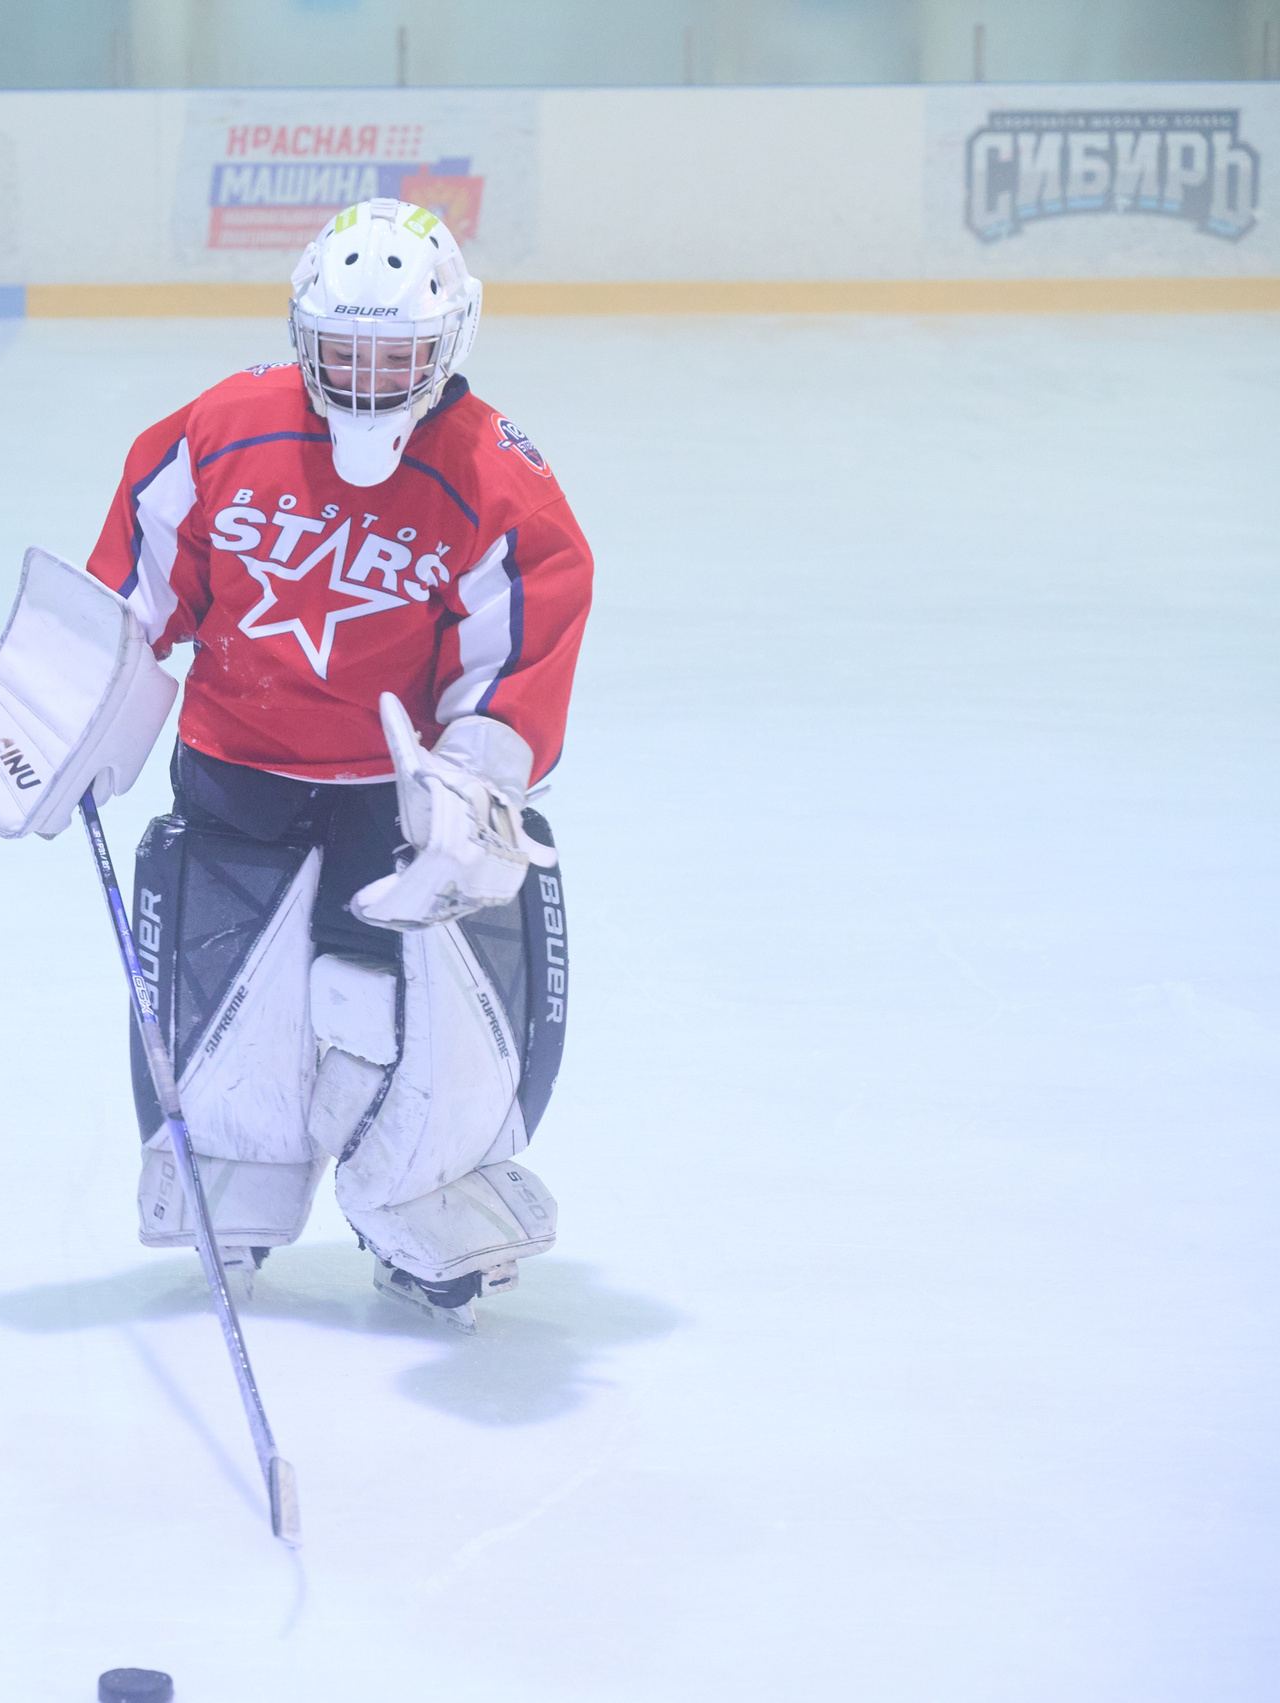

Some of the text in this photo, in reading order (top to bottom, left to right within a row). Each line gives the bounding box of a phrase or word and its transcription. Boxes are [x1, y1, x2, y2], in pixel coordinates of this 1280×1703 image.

[221, 165, 380, 204] МАШИНА
[970, 130, 1257, 240] СИБИРЬ
[132, 975, 156, 1016] GSX
[204, 984, 250, 1059] SUPREME
[475, 992, 512, 1061] SUPREME
